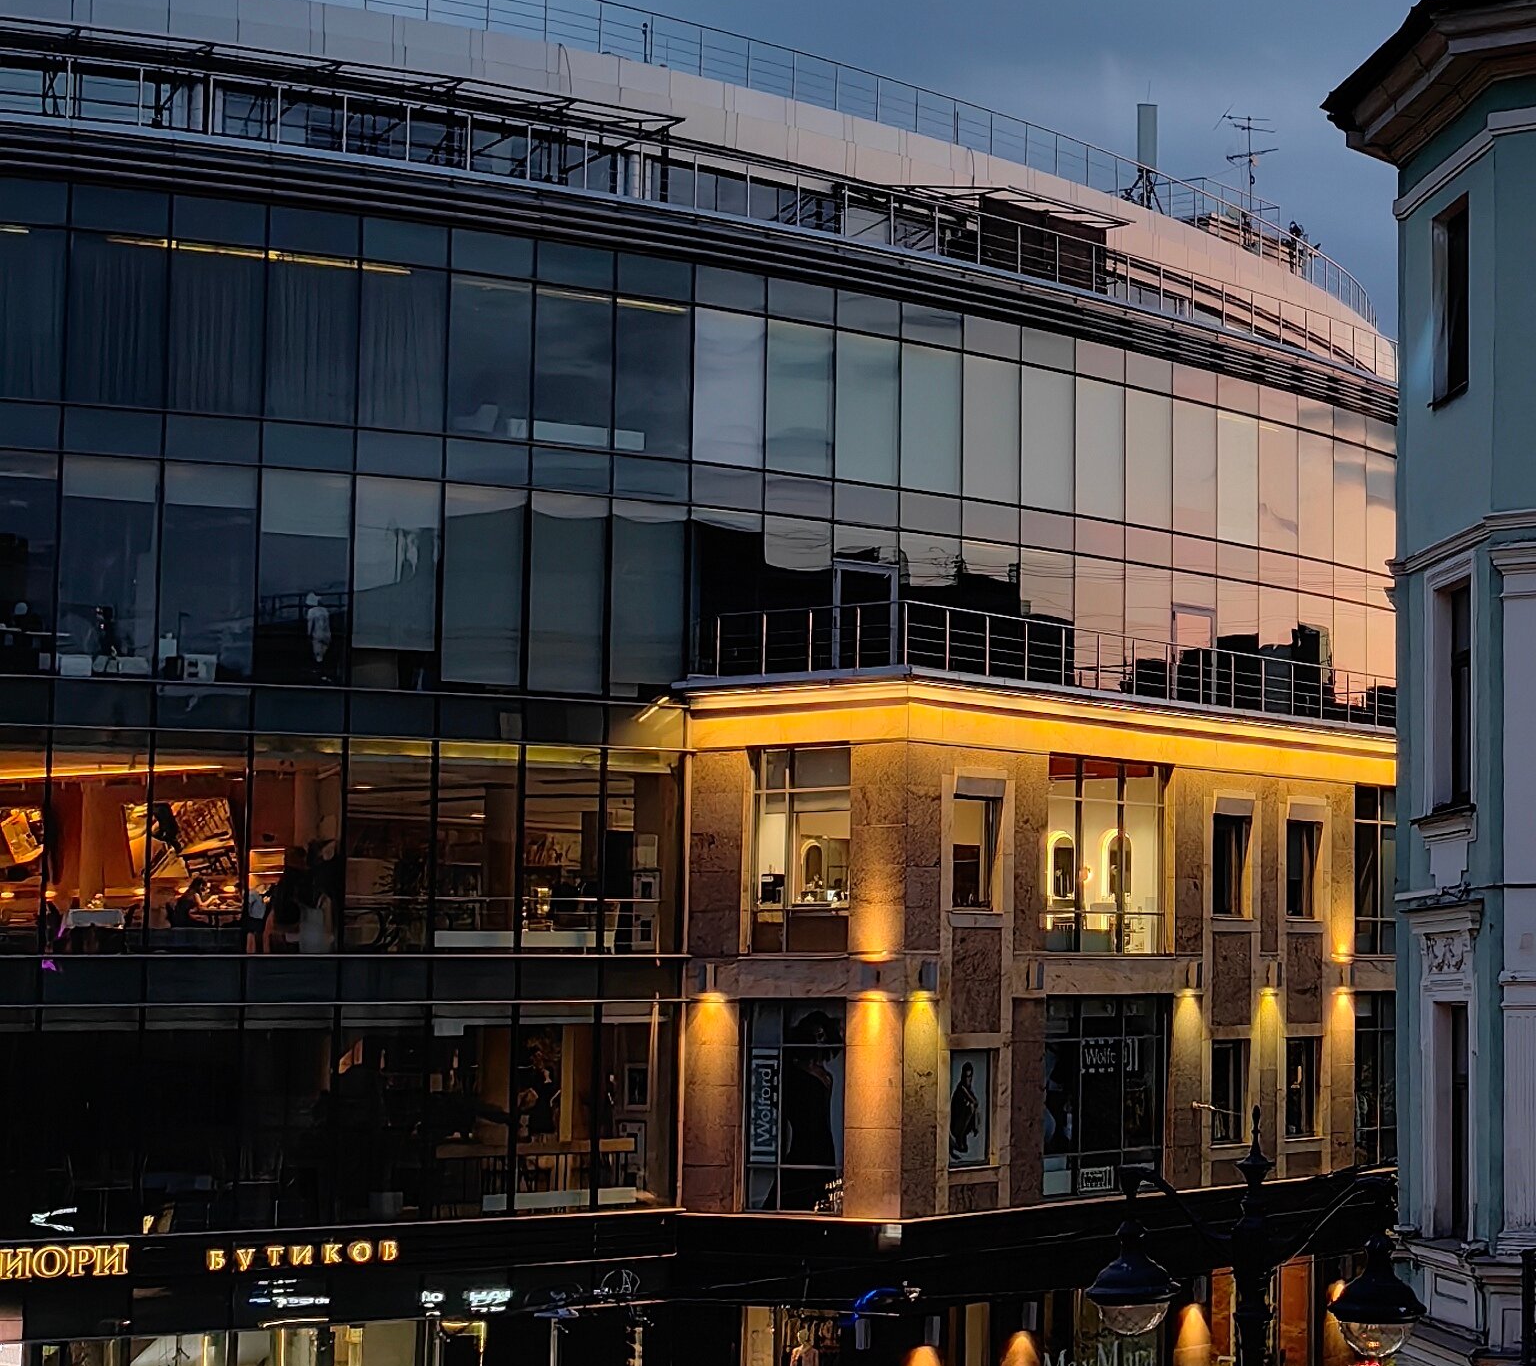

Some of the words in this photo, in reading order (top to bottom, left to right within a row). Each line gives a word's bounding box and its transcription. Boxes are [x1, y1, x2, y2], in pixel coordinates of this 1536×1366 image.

[757, 1068, 772, 1142] Wolford
[0, 1243, 129, 1280] ИОРИ
[208, 1240, 398, 1271] БУТИКОВ
